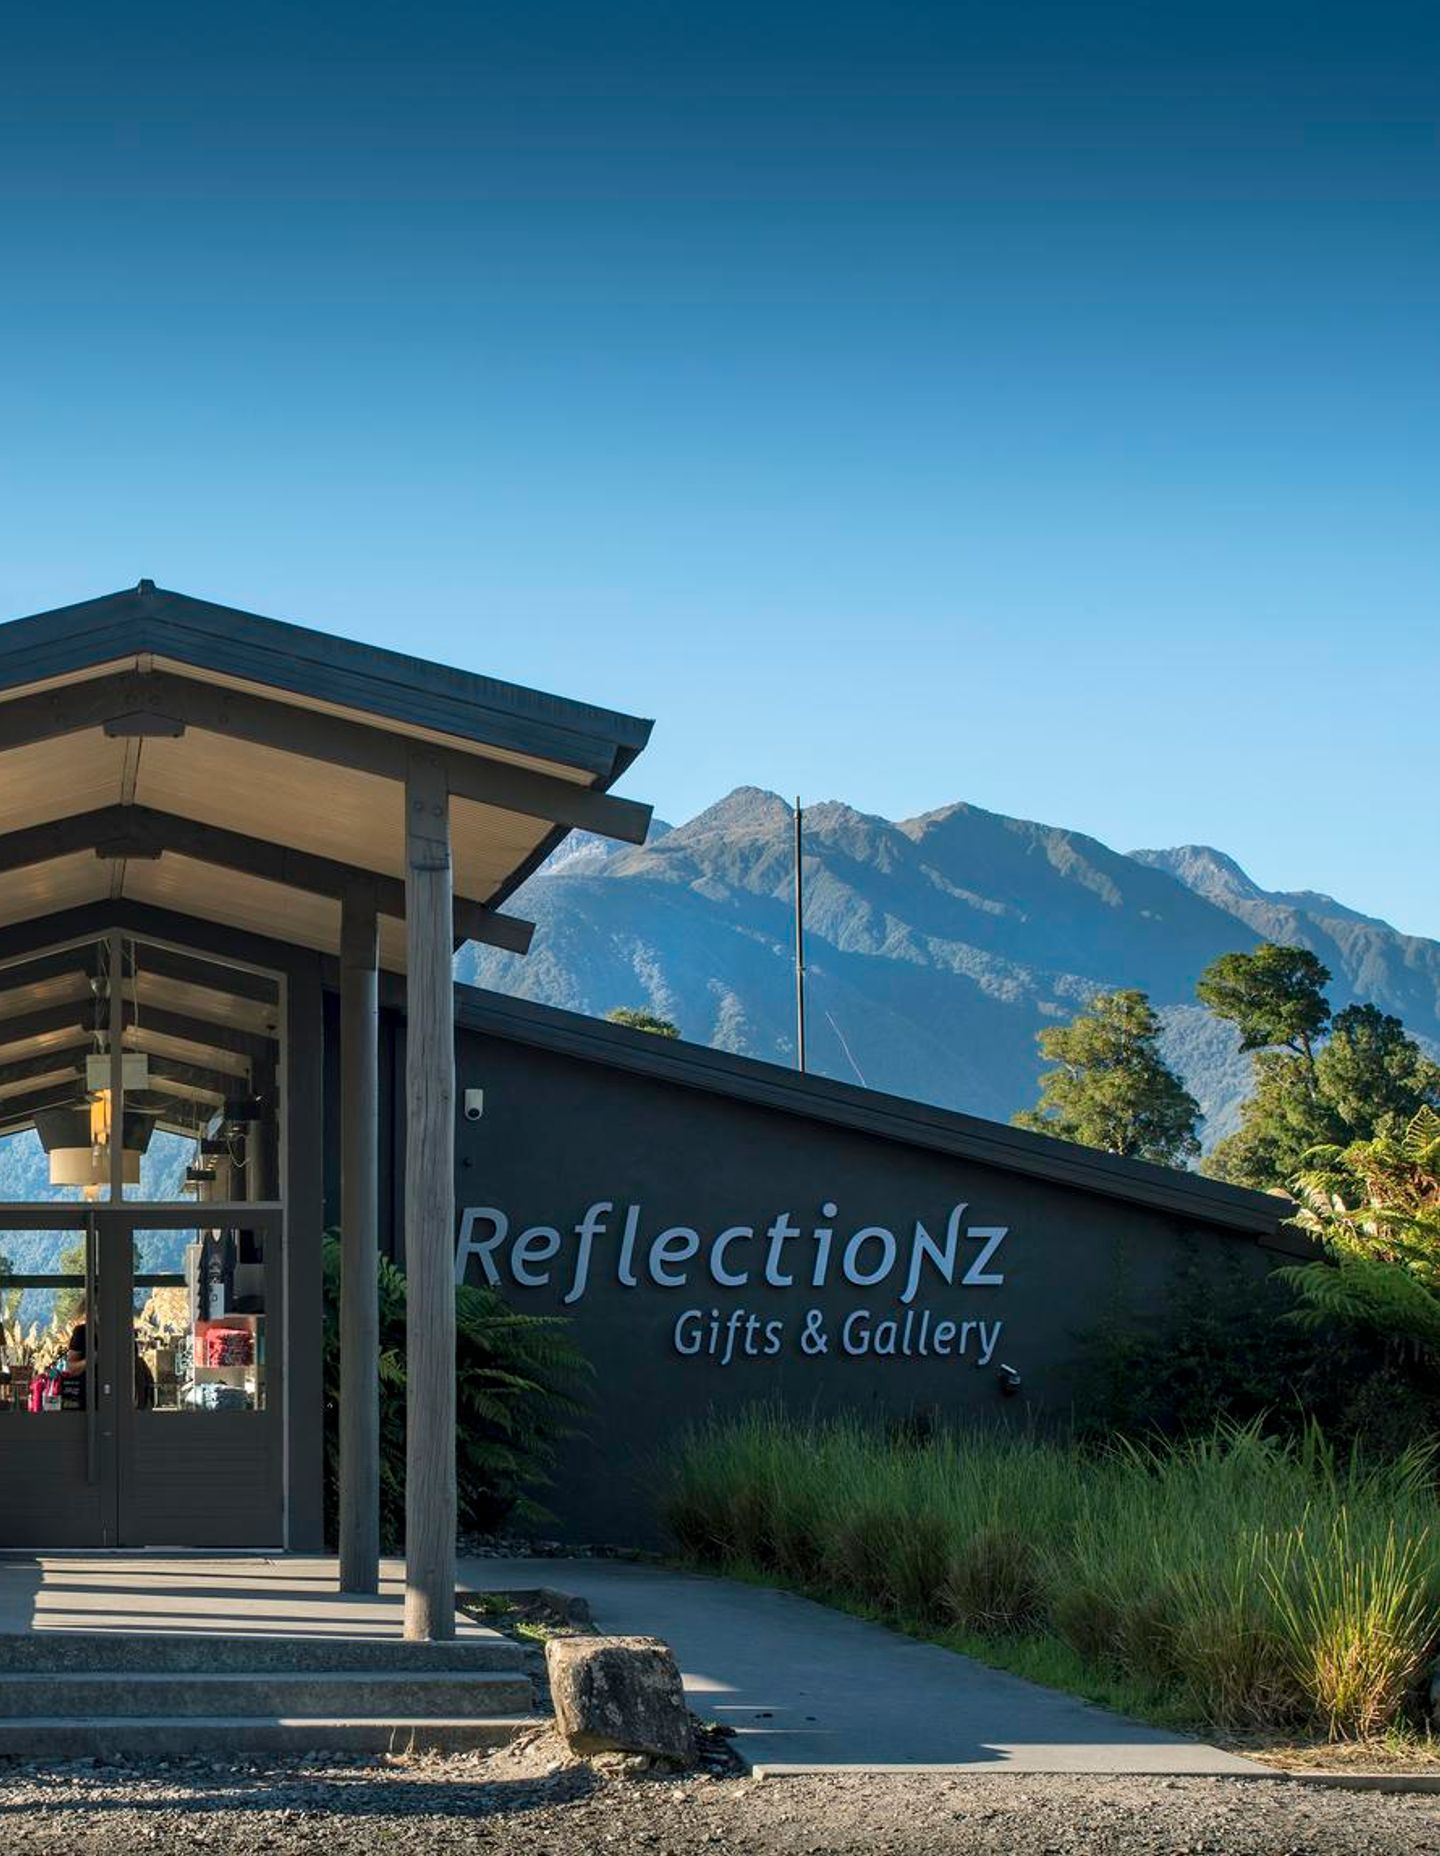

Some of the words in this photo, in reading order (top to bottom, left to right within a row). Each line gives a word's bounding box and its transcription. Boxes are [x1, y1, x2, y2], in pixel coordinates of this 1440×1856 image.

[674, 1309, 783, 1366] Gifts
[801, 1309, 829, 1355] &
[843, 1309, 1002, 1366] Gallery
